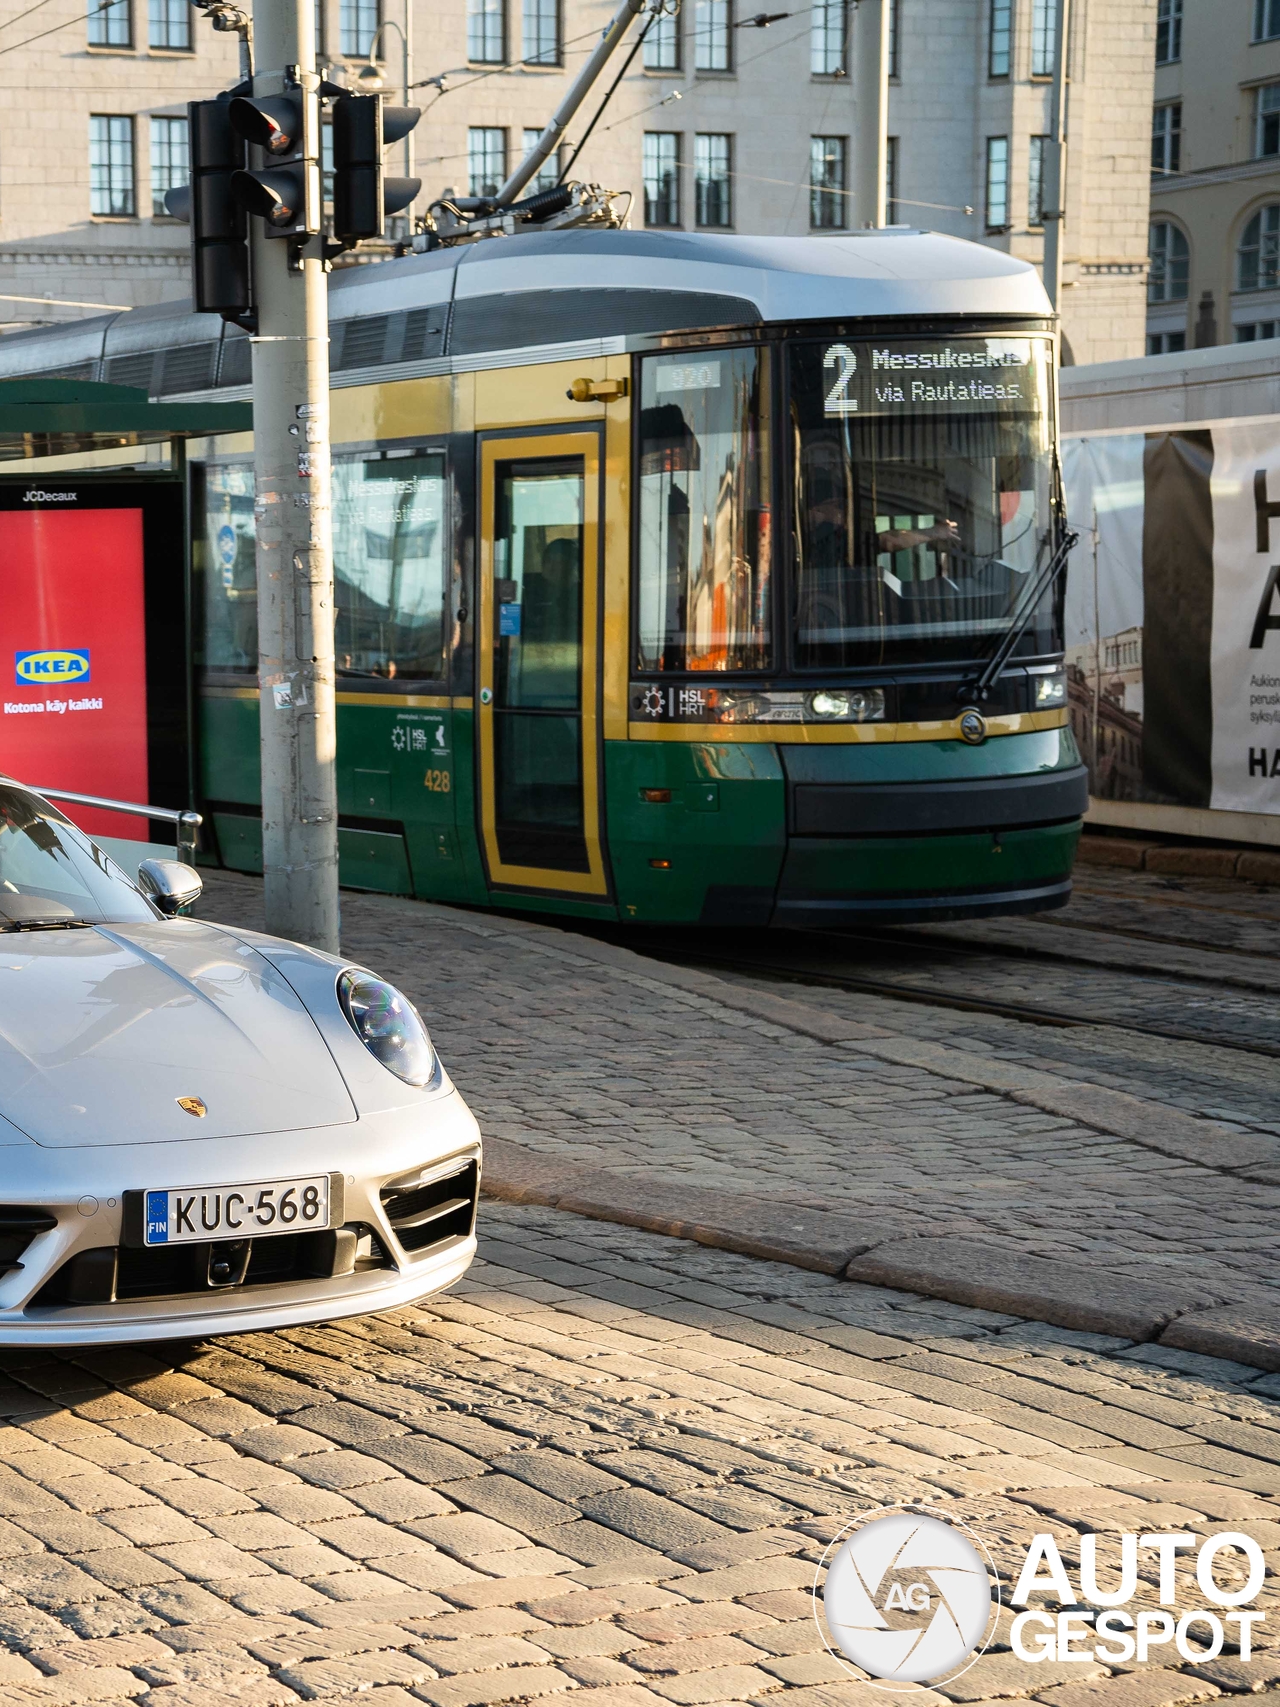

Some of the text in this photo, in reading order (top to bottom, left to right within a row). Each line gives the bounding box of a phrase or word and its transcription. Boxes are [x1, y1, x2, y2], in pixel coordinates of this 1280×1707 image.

[672, 366, 712, 388] 920
[823, 344, 857, 411] 2
[876, 382, 904, 402] via
[23, 491, 77, 501] JCDecaux
[23, 660, 83, 674] IKEA
[679, 690, 705, 702] HSL
[4, 698, 103, 714] Kotona käy kaikki
[679, 703, 705, 715] HRT
[412, 729, 427, 739] HSL
[412, 740, 427, 750] HRT
[424, 769, 450, 792] 428
[176, 1186, 319, 1233] KUC-568
[149, 1222, 167, 1234] FIN
